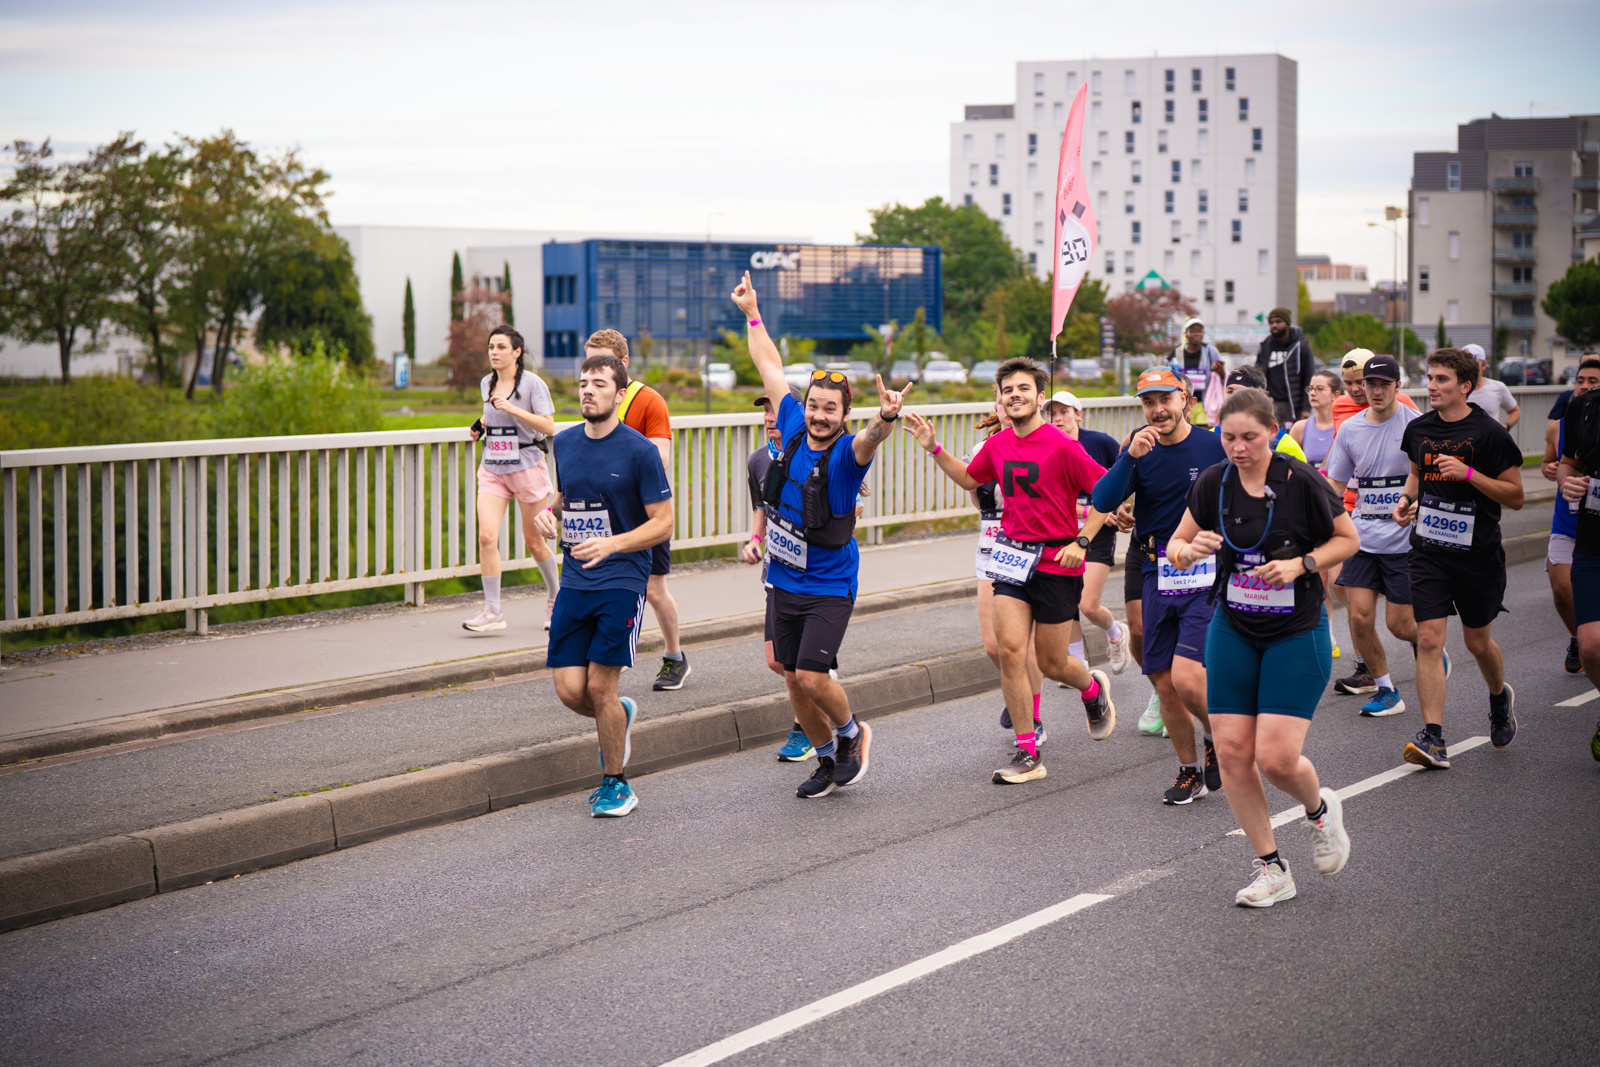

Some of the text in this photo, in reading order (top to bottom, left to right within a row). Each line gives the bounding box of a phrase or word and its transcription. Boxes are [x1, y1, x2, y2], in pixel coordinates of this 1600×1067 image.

[1003, 460, 1041, 498] R
[1424, 472, 1462, 482] FINI
[805, 486, 816, 528] KIPRUN
[1363, 492, 1399, 505] 42466
[563, 517, 604, 531] 44242
[1423, 514, 1467, 533] 42969
[768, 529, 802, 556] 42906
[1429, 530, 1458, 539] ALEXANDRE
[768, 542, 797, 562] EAN-BAPTISTE
[992, 550, 1028, 569] 43934
[1244, 592, 1269, 601] MARINE
